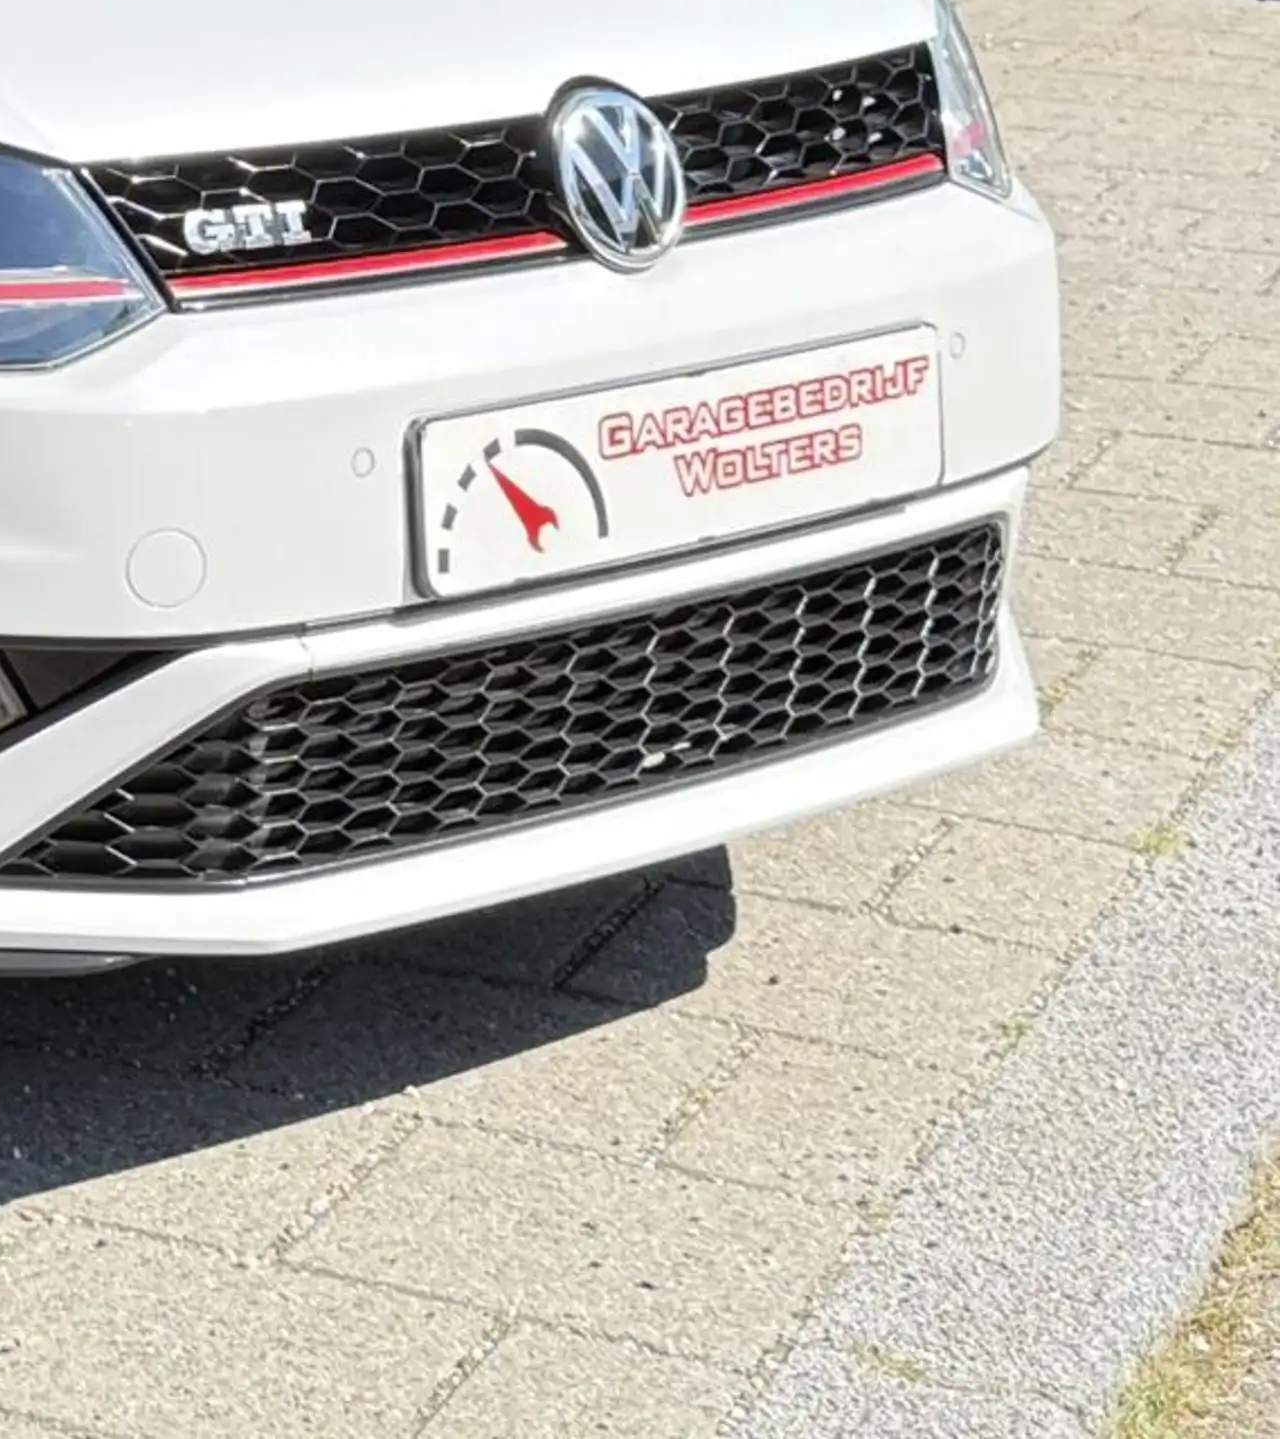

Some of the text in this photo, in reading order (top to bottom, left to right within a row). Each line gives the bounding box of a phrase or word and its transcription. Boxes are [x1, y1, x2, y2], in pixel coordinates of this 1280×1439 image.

[183, 199, 313, 255] GTI
[598, 355, 930, 461] GARAGEBEDRIJF
[672, 422, 863, 498] WOLTERS
